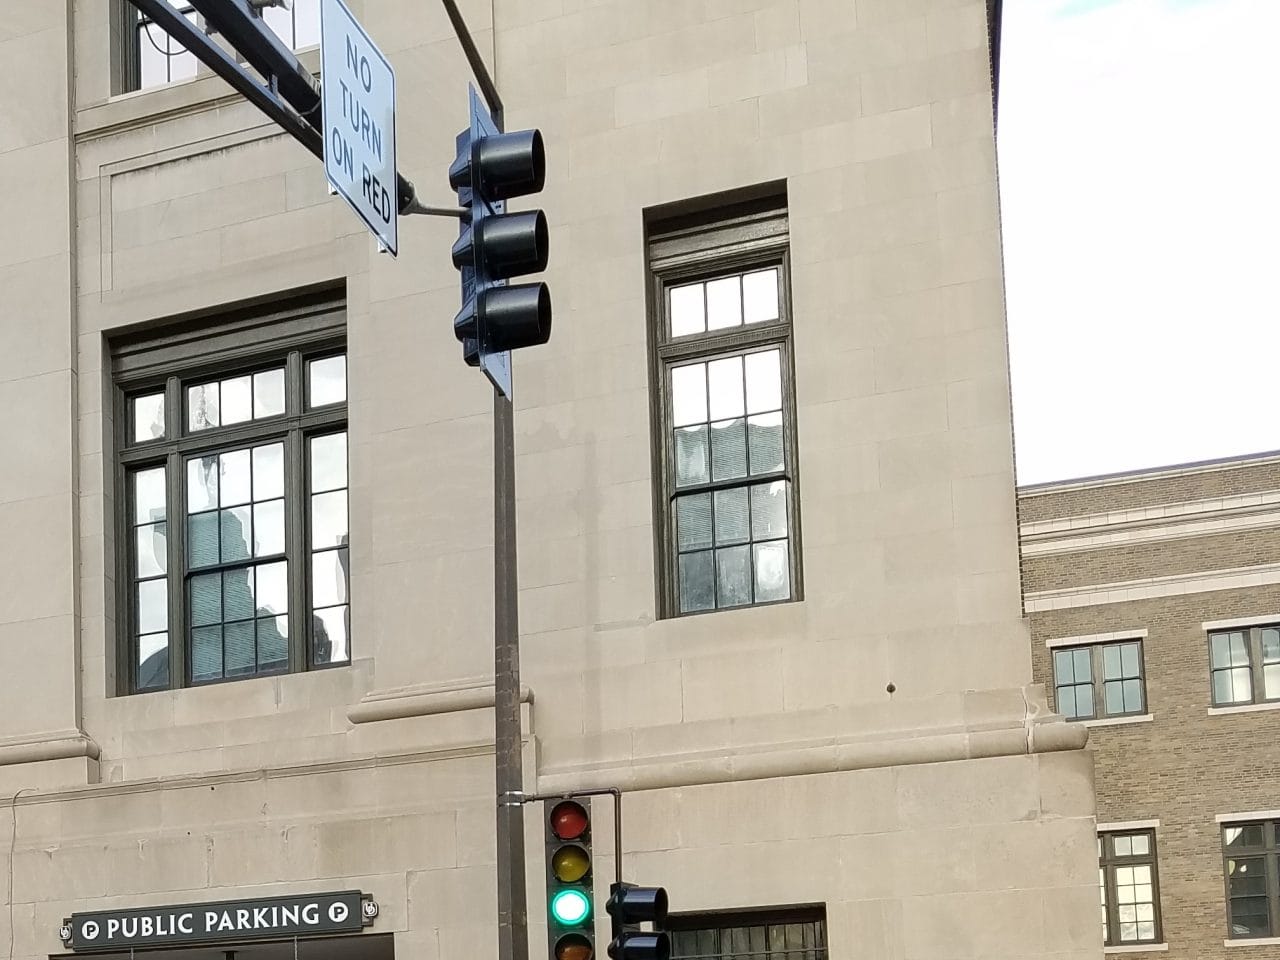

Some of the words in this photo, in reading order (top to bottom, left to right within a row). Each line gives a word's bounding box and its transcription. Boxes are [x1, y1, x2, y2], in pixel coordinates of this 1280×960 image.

[346, 34, 372, 93] NO
[339, 78, 382, 163] TURN
[332, 127, 354, 183] ON
[363, 162, 391, 224] RED
[107, 912, 194, 939] PUBLIC
[205, 902, 320, 932] PARKING
